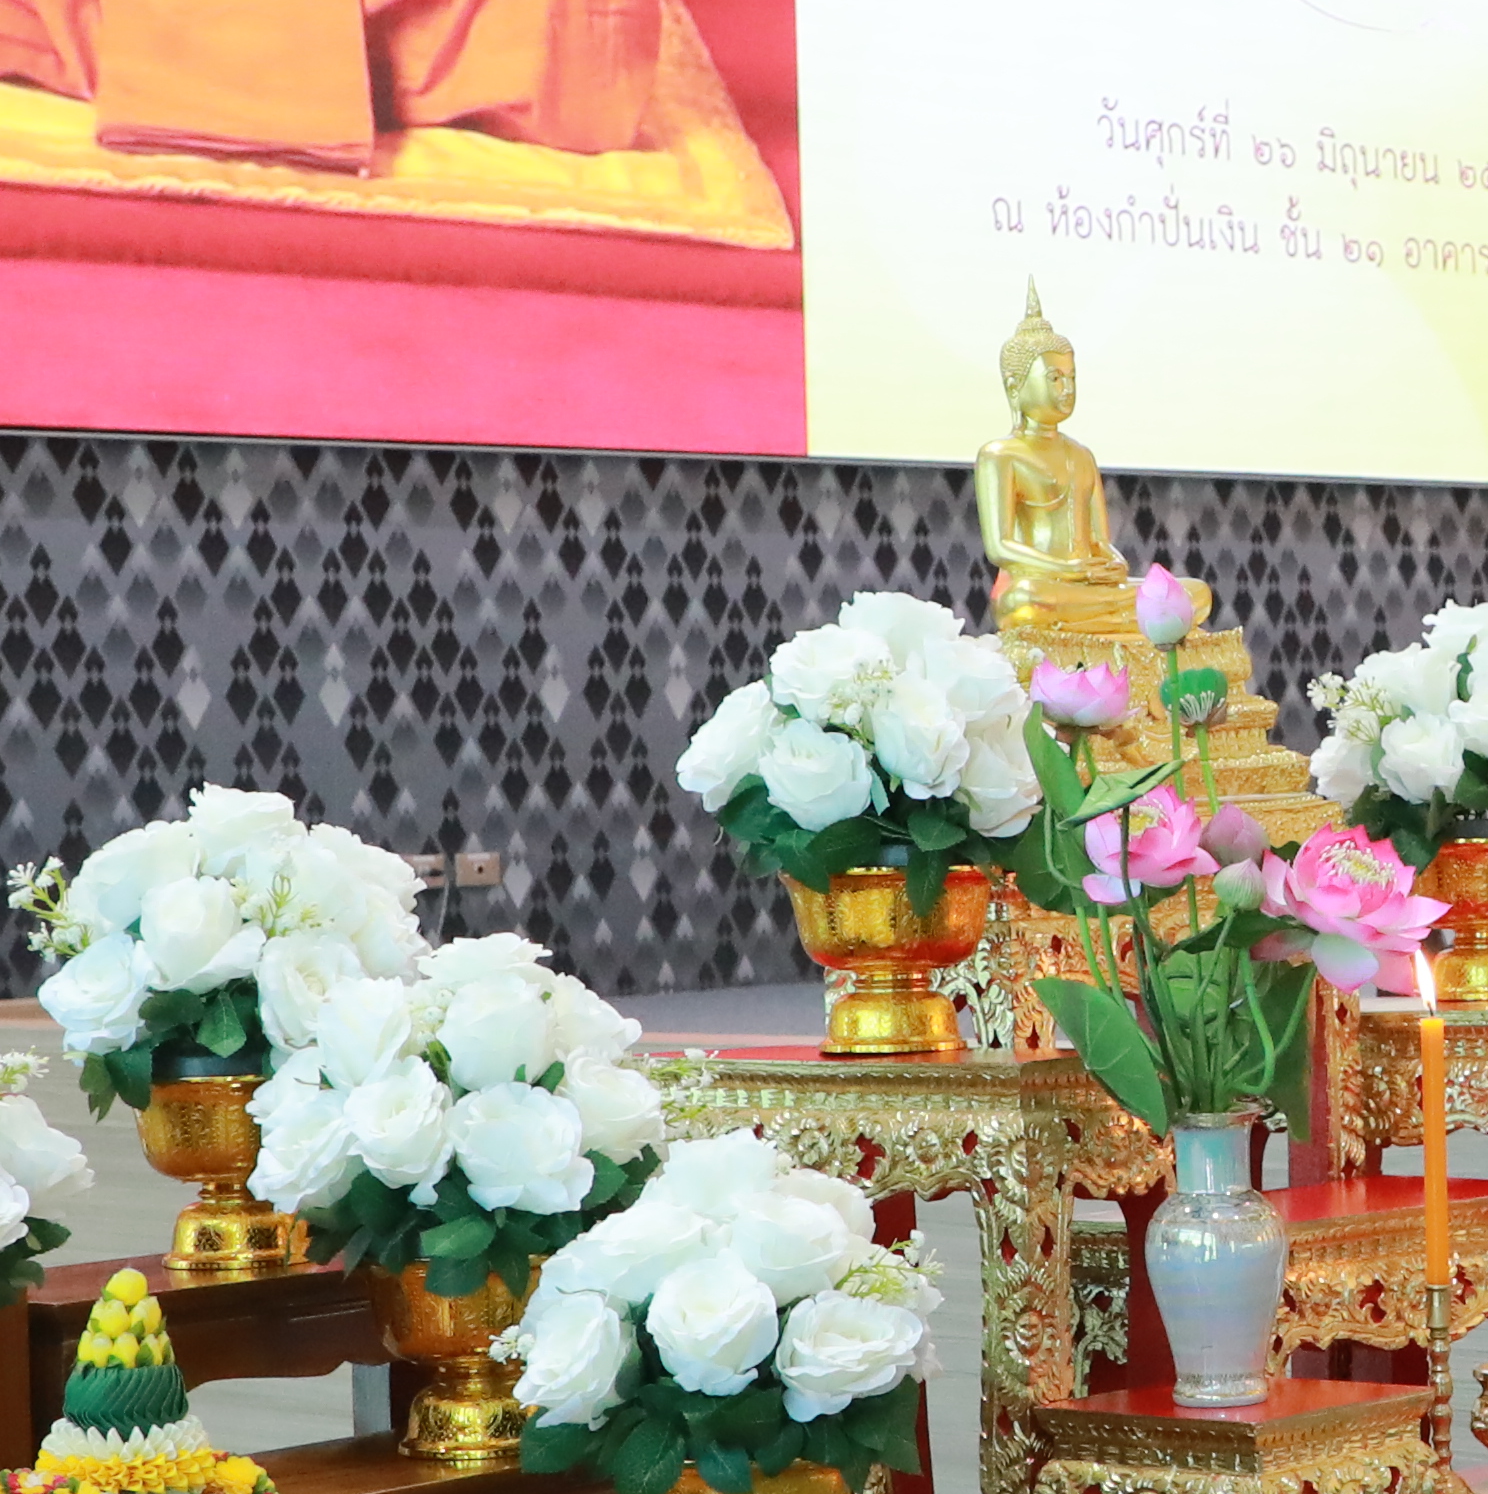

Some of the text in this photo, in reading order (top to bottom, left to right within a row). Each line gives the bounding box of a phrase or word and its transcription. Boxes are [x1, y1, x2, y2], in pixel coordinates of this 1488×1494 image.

[1096, 97, 1231, 169] วันศุกร์ที่
[1251, 134, 1297, 169] ๒๖
[1315, 126, 1441, 190] มิถุนายน
[991, 196, 1025, 234] ณ
[1045, 183, 1260, 255] ห้องกำปั่นเงิน
[1279, 194, 1323, 261] ชั้น
[1340, 233, 1385, 268] ๒๑
